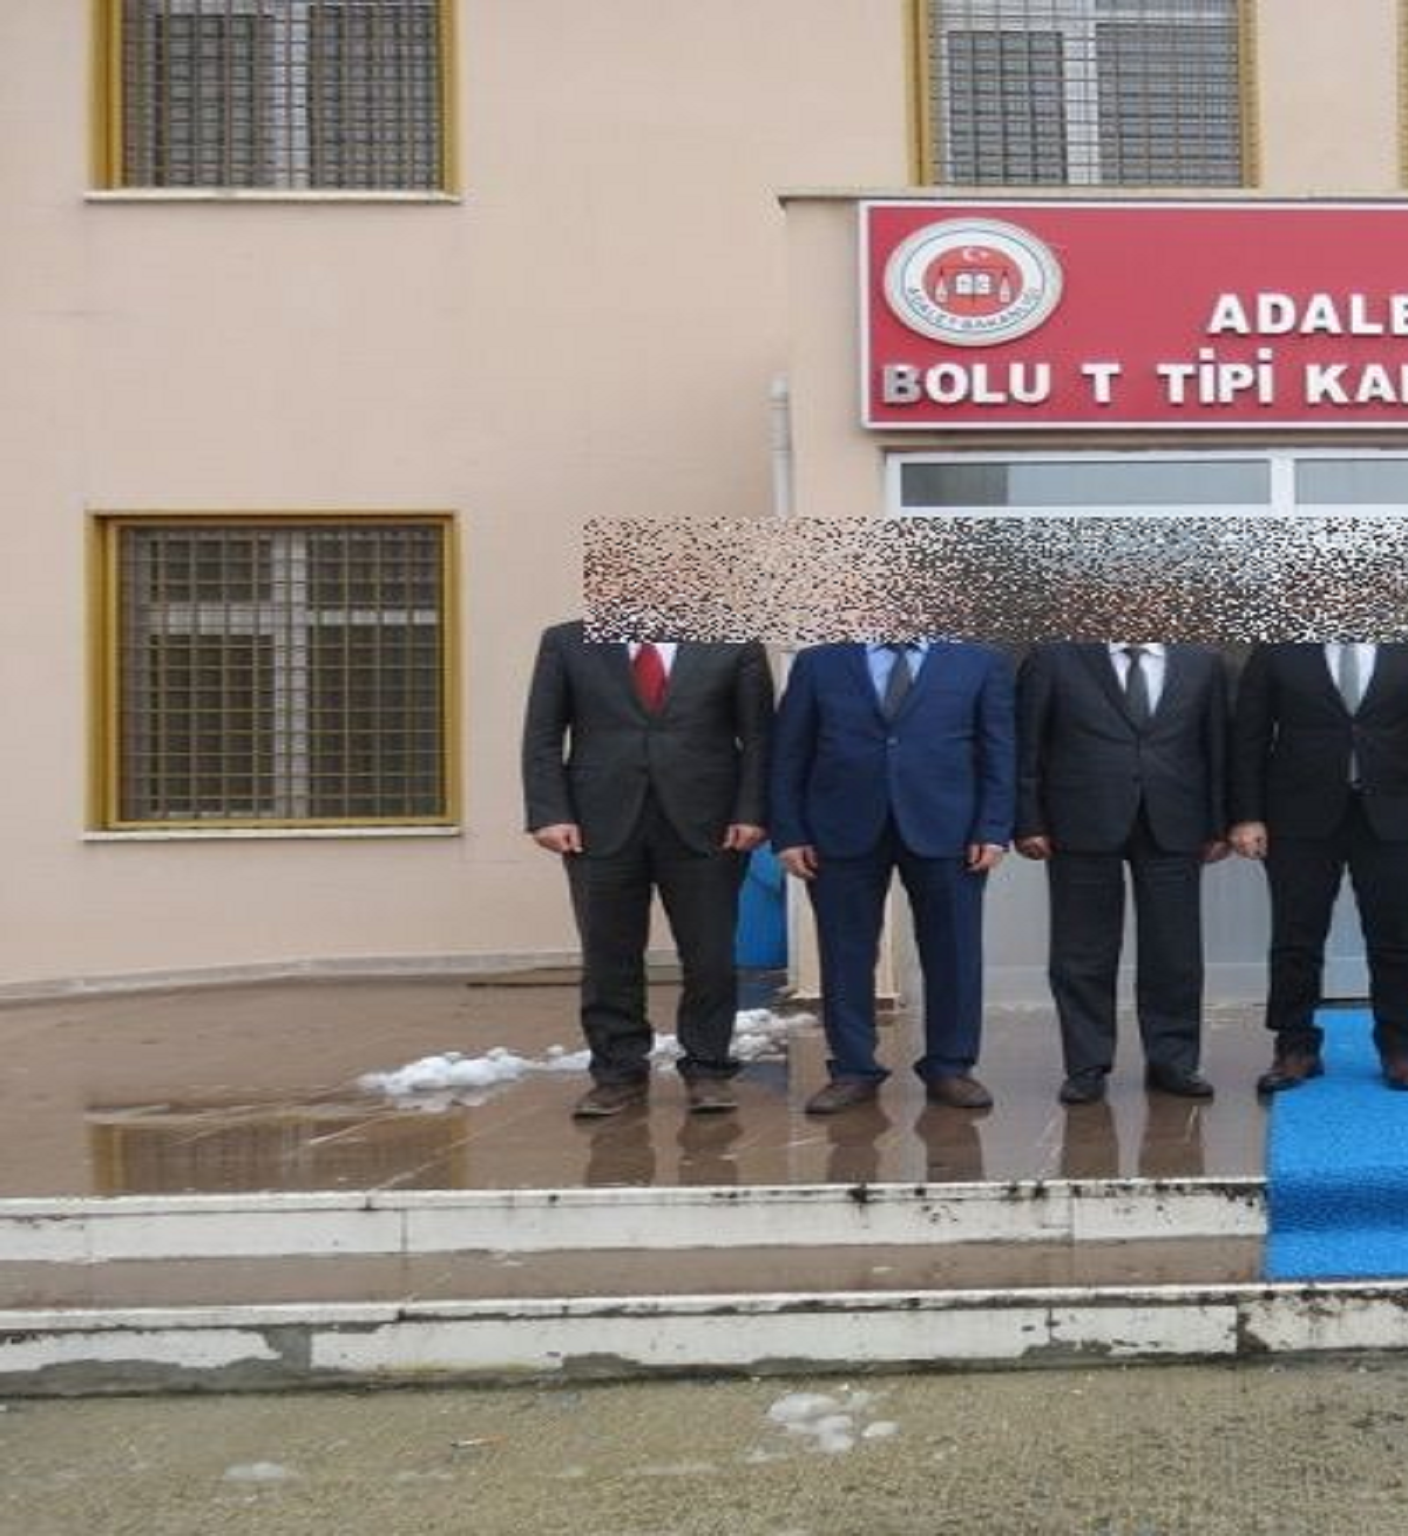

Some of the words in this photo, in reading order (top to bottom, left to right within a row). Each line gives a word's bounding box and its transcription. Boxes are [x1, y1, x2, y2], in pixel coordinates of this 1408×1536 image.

[882, 362, 1051, 403] BOLU
[1081, 362, 1121, 403] T
[1156, 346, 1274, 404] TİPİ
